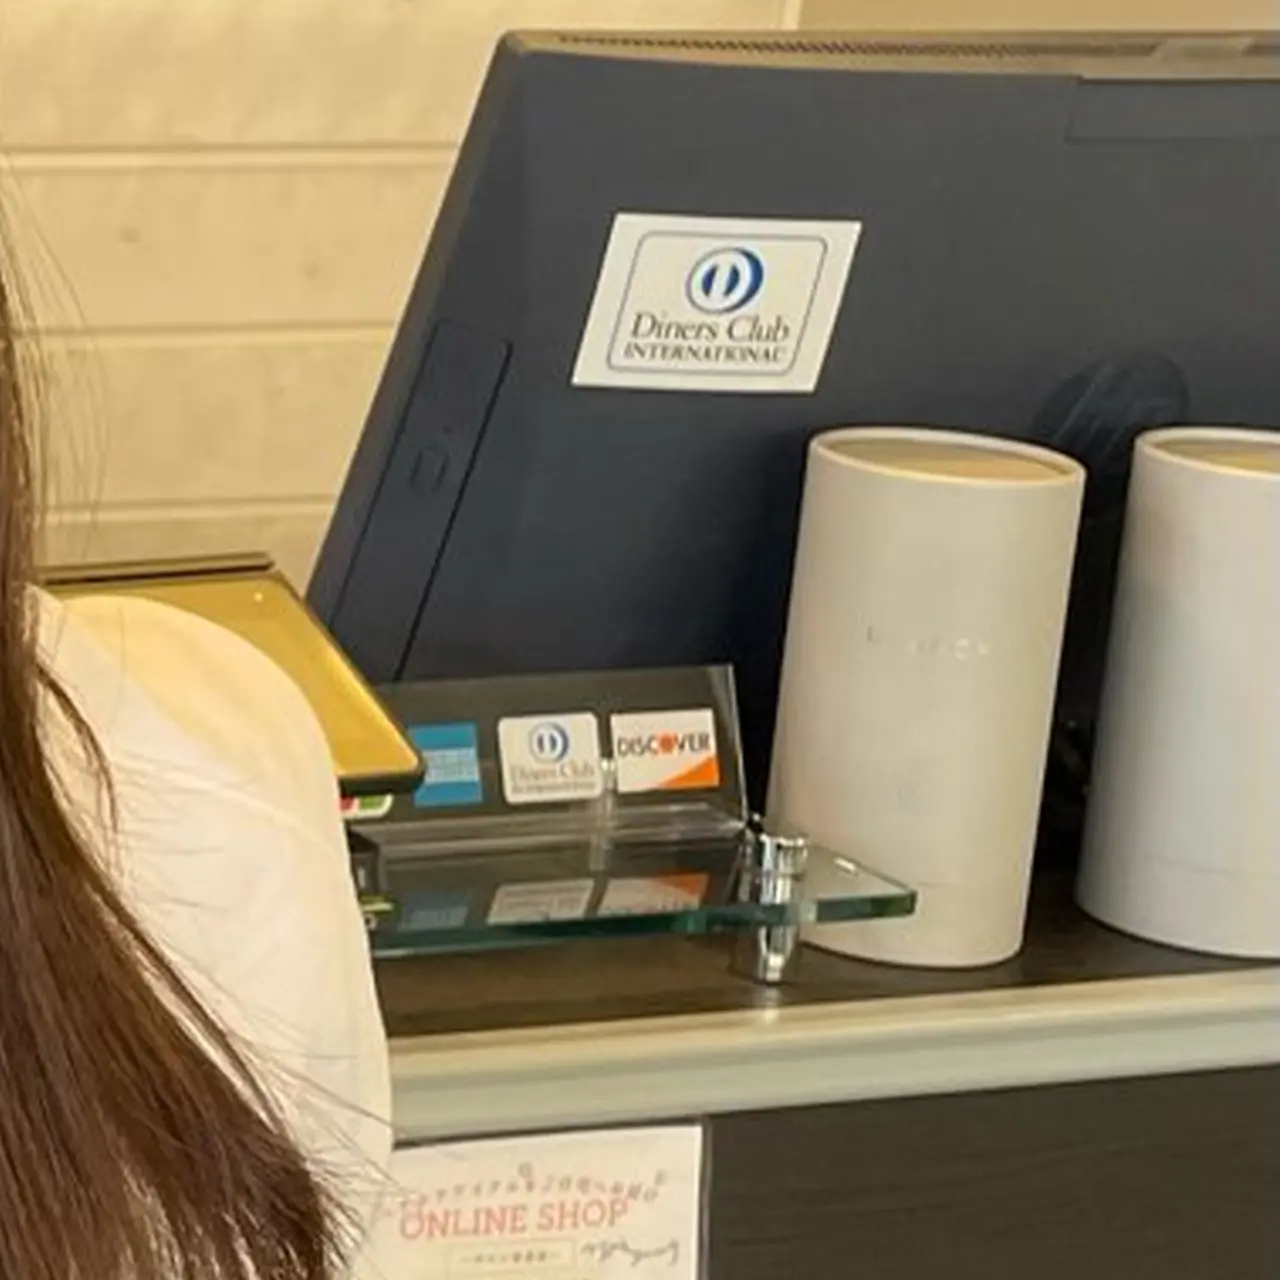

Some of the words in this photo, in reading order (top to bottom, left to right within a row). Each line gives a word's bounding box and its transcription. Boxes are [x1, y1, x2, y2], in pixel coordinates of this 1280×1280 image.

[630, 311, 719, 341] Diners
[727, 312, 791, 342] Club
[623, 341, 785, 363] INTERNATIONAL
[616, 731, 711, 757] DISCOVER
[400, 1204, 528, 1240] ONLINE
[537, 1194, 631, 1232] SHOP
